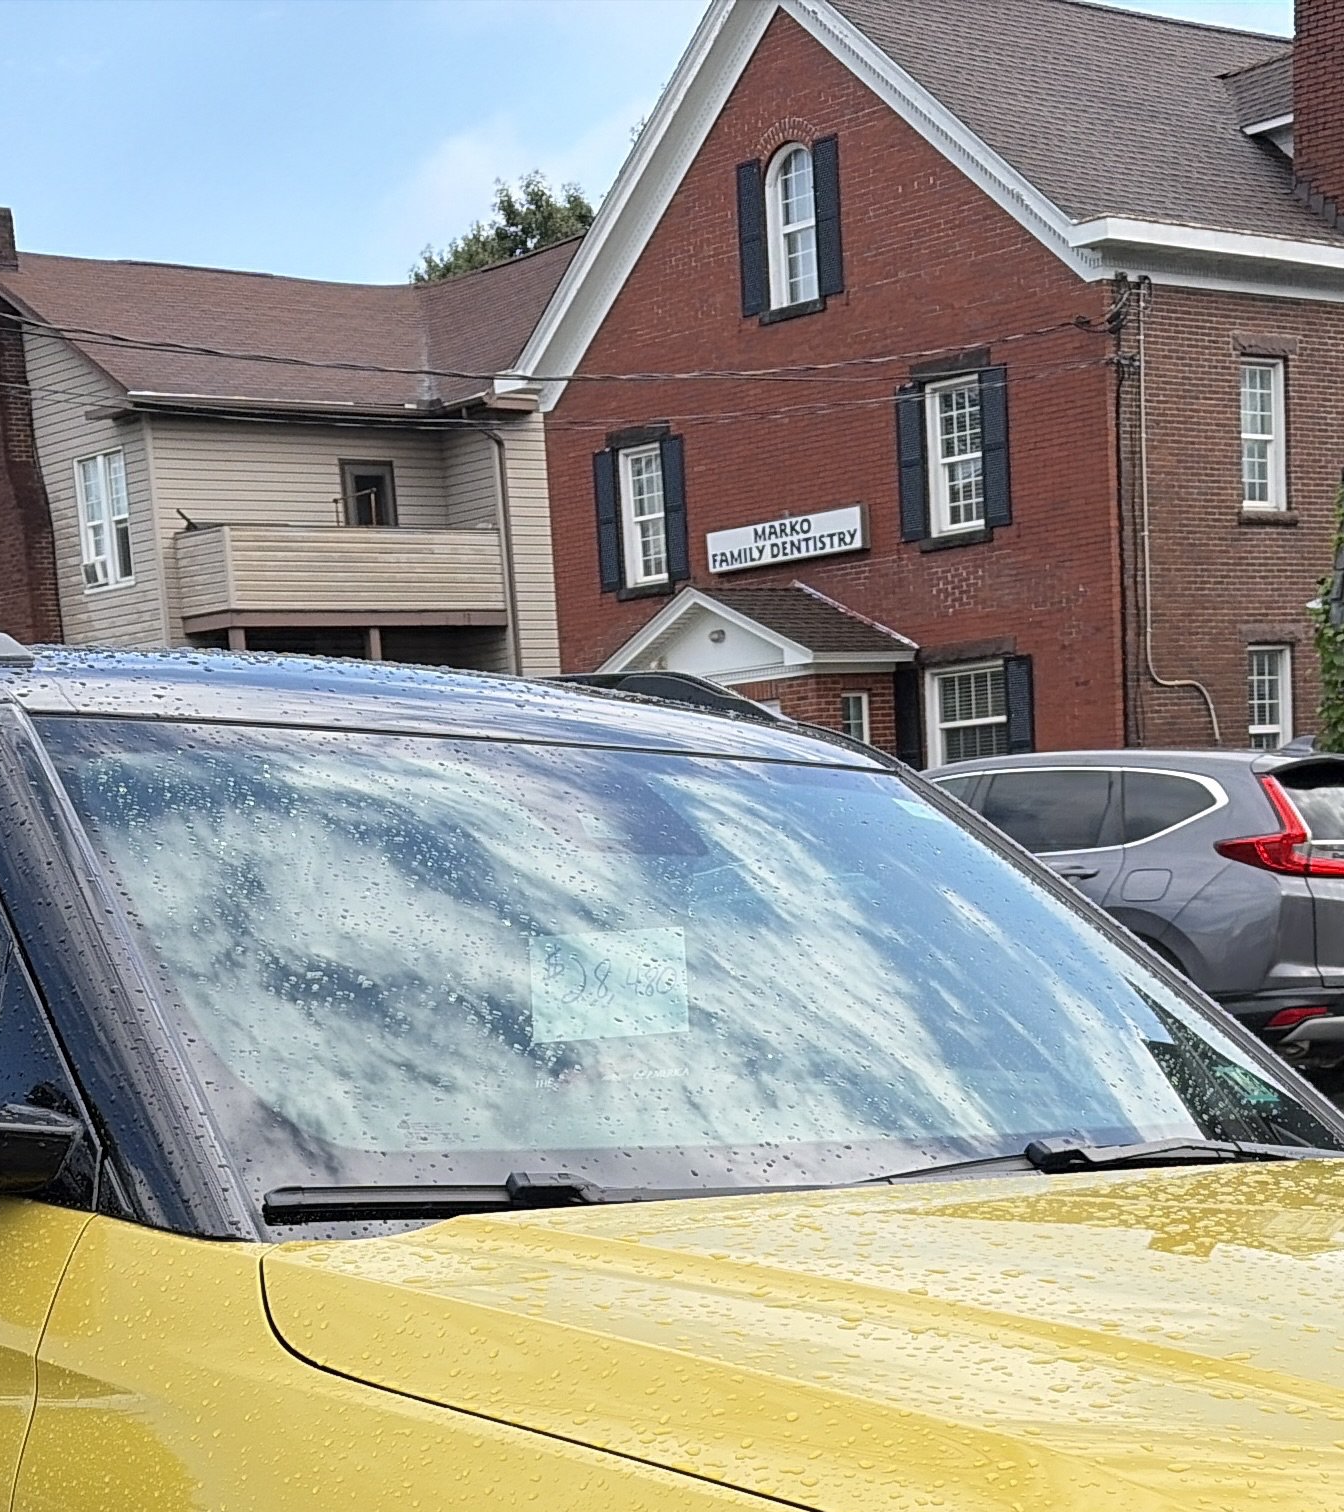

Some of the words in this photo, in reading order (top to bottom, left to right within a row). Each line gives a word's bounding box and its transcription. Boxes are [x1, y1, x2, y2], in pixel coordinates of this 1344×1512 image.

[753, 518, 812, 543] MARKO
[711, 545, 767, 569] FAMILY
[770, 528, 858, 559] DENTISTRY
